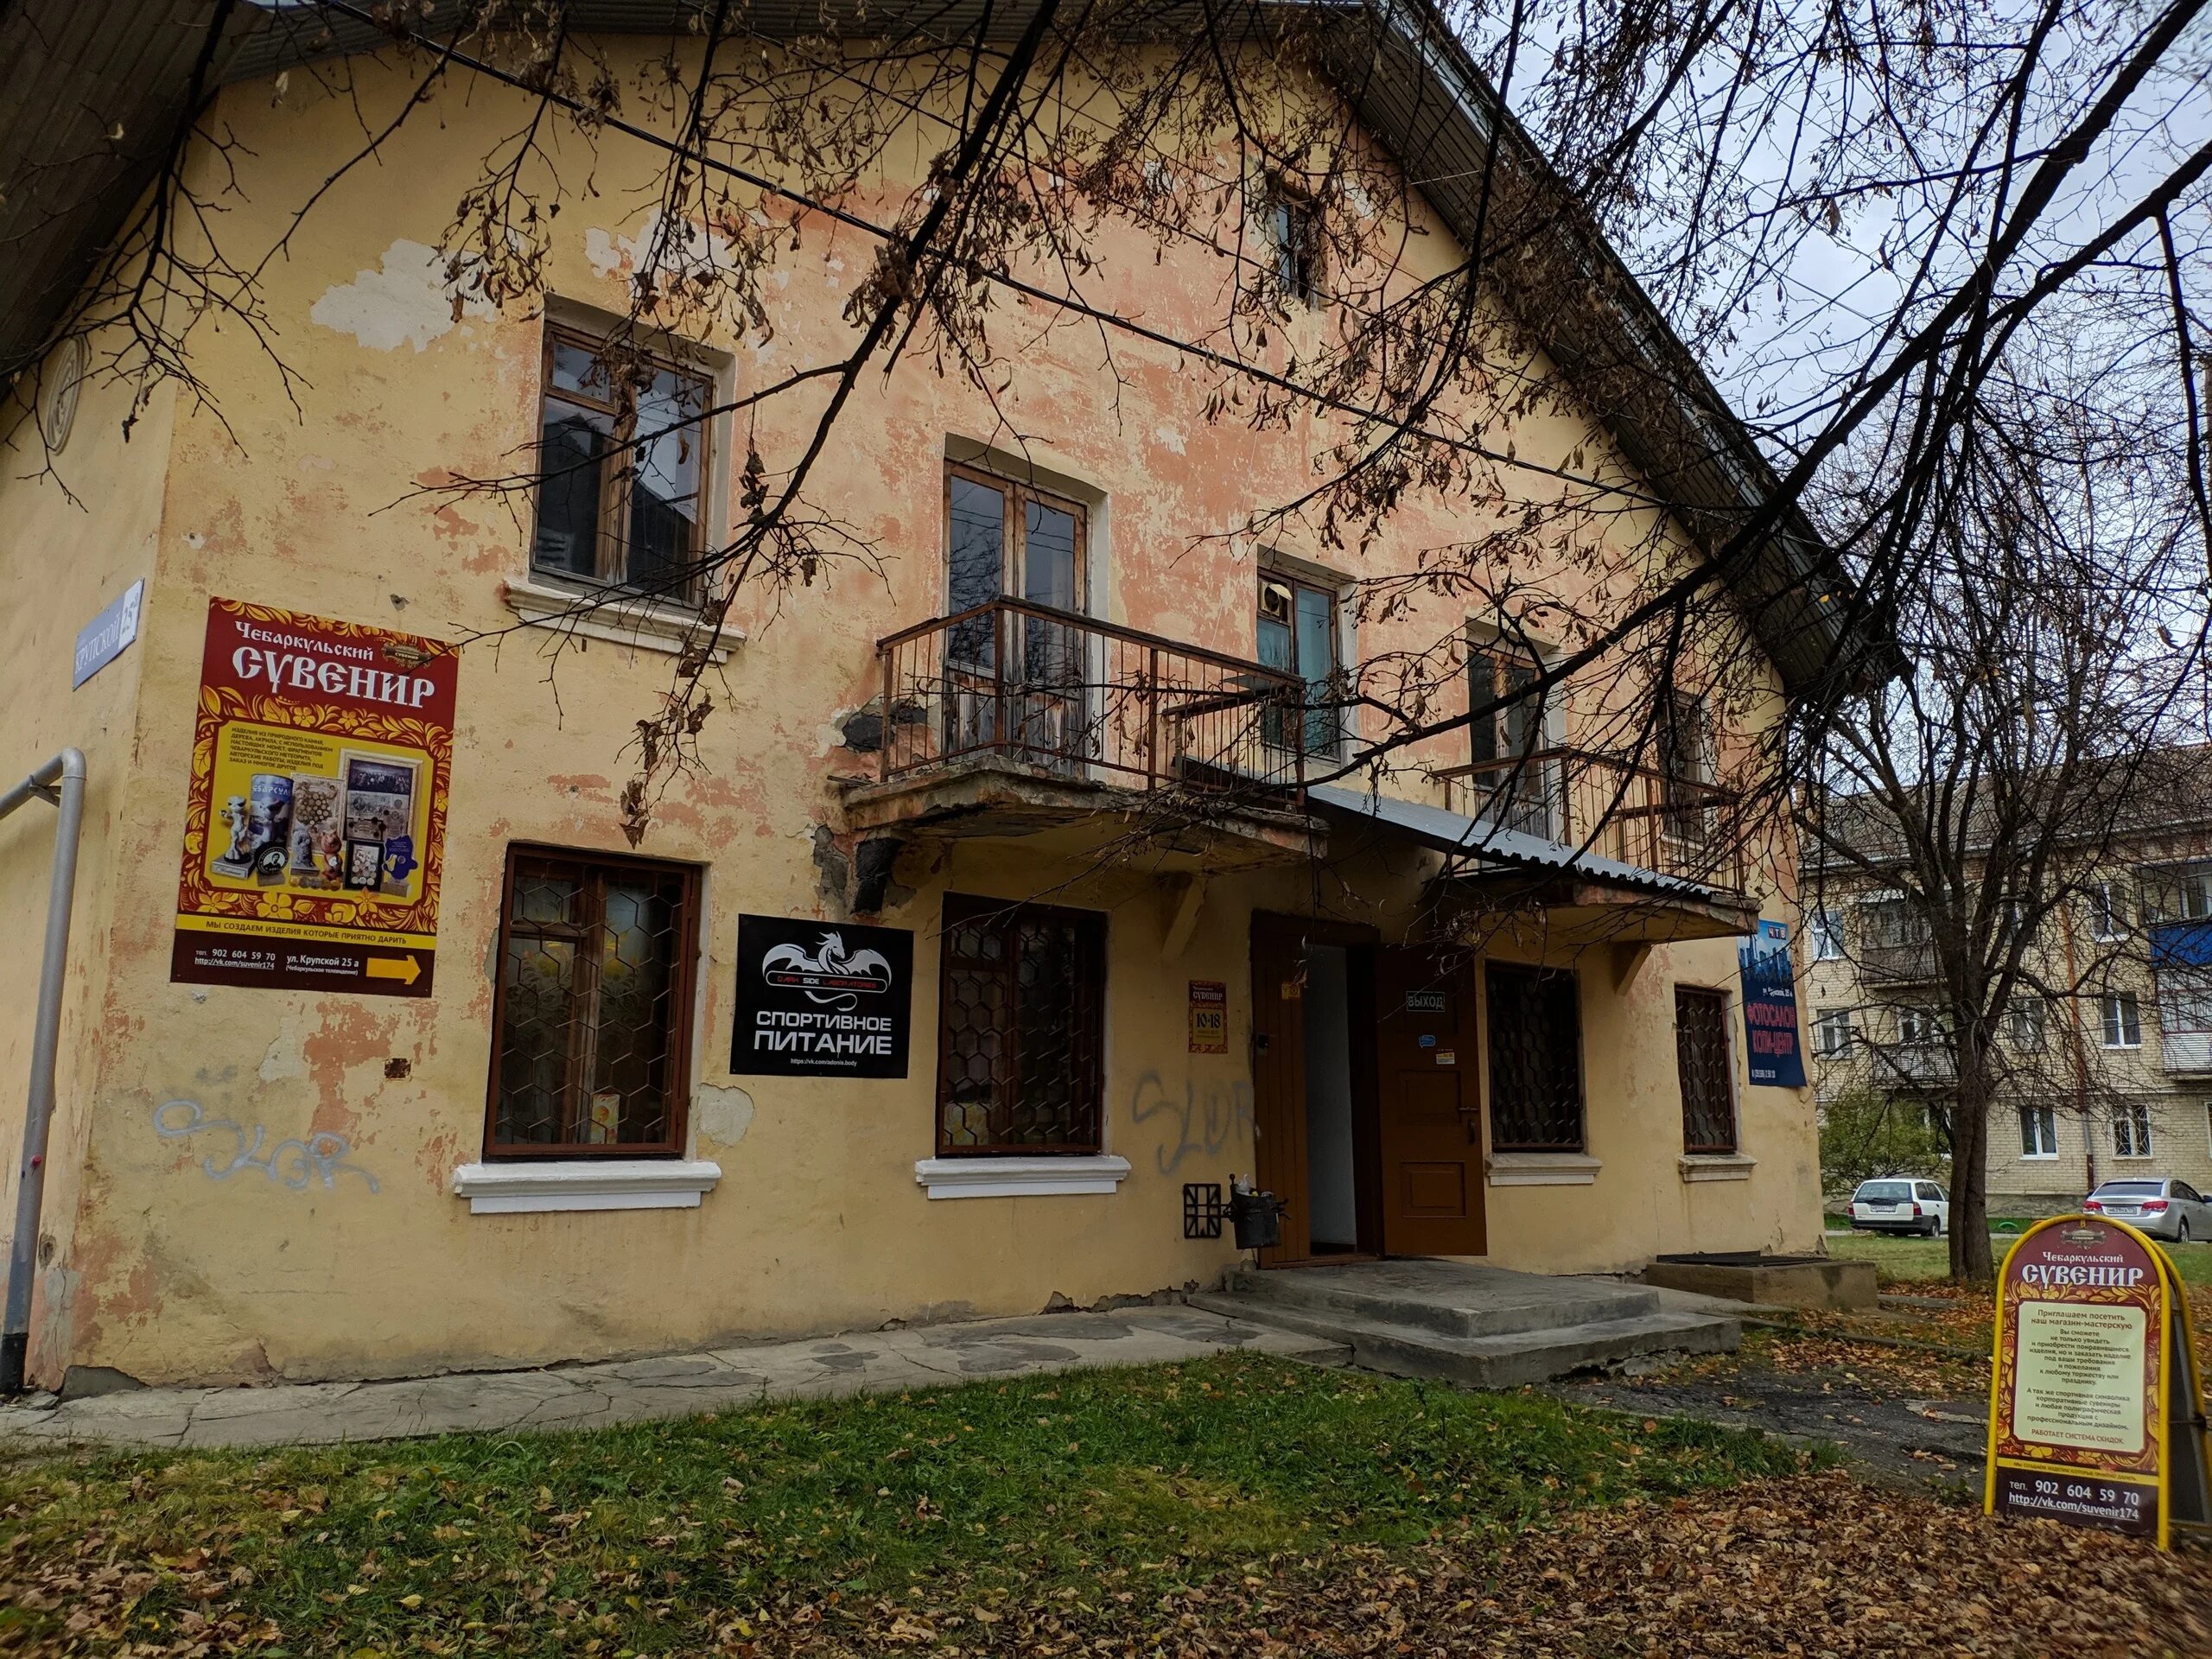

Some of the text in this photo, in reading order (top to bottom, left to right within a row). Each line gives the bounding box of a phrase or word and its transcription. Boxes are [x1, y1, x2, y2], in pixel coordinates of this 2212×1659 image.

[75, 612, 120, 675] КРУПСКОЙ
[234, 620, 374, 662] Чебаркульский
[232, 646, 435, 709] СУВЕНИР
[267, 730, 303, 742] ПРИРОДНОГО
[230, 745, 278, 756] ЧЕБАРКУЛЬСКОГО
[231, 739, 265, 748] НАСТОЯЩИХ
[288, 747, 322, 757] ФРАГМЕНТОВ
[229, 751, 261, 760] АВТОРСКИЕ
[224, 923, 264, 932] СОЗДАЕМ
[265, 927, 302, 936] ИЗДЕЛИЯ
[303, 930, 340, 938] КОТОРЫЕ
[341, 933, 376, 942] ПРИЯТНО
[378, 936, 406, 944] ДАРИТЬ
[212, 949, 227, 957] 902
[232, 950, 247, 959] 604
[194, 957, 275, 969] http://vk.com/suvenir174
[287, 956, 299, 964] ул.
[300, 955, 340, 966] Крупской
[341, 957, 352, 967] 25
[1408, 995, 1443, 1010] ВЫХОД
[756, 1010, 893, 1032] СПОРТИВНОЕ
[1746, 1002, 1796, 1028] ФОТОСАЛОН
[753, 1030, 893, 1055] ПИТАНИЕ
[1752, 1030, 1794, 1058] КОПИ-ЦЕНТР
[2043, 1252, 2124, 1264] Чебаркульский
[2021, 1264, 2144, 1290] СУВЕНИР
[2037, 1309, 2087, 1319] Приглашаем
[2049, 1319, 2133, 1331] магазин-мастерскую
[2037, 1341, 2075, 1350] приобрести
[2076, 1344, 2129, 1353] понравившиеся
[2036, 1395, 2088, 1405] корпоративные
[2056, 1390, 2094, 1399] спортивная
[2058, 1410, 2093, 1420] продукция
[2063, 1405, 2121, 1415] полиграфическая
[2026, 1414, 2093, 1427] профессиональным
[2031, 1428, 2063, 1438] РАБОТАЕТ
[2065, 1433, 2095, 1441] СИСТЕМА
[2009, 1480, 2139, 1506] тел. 902 604 59 70
[2008, 1491, 2139, 1522] http://vk.com/suvenir174
